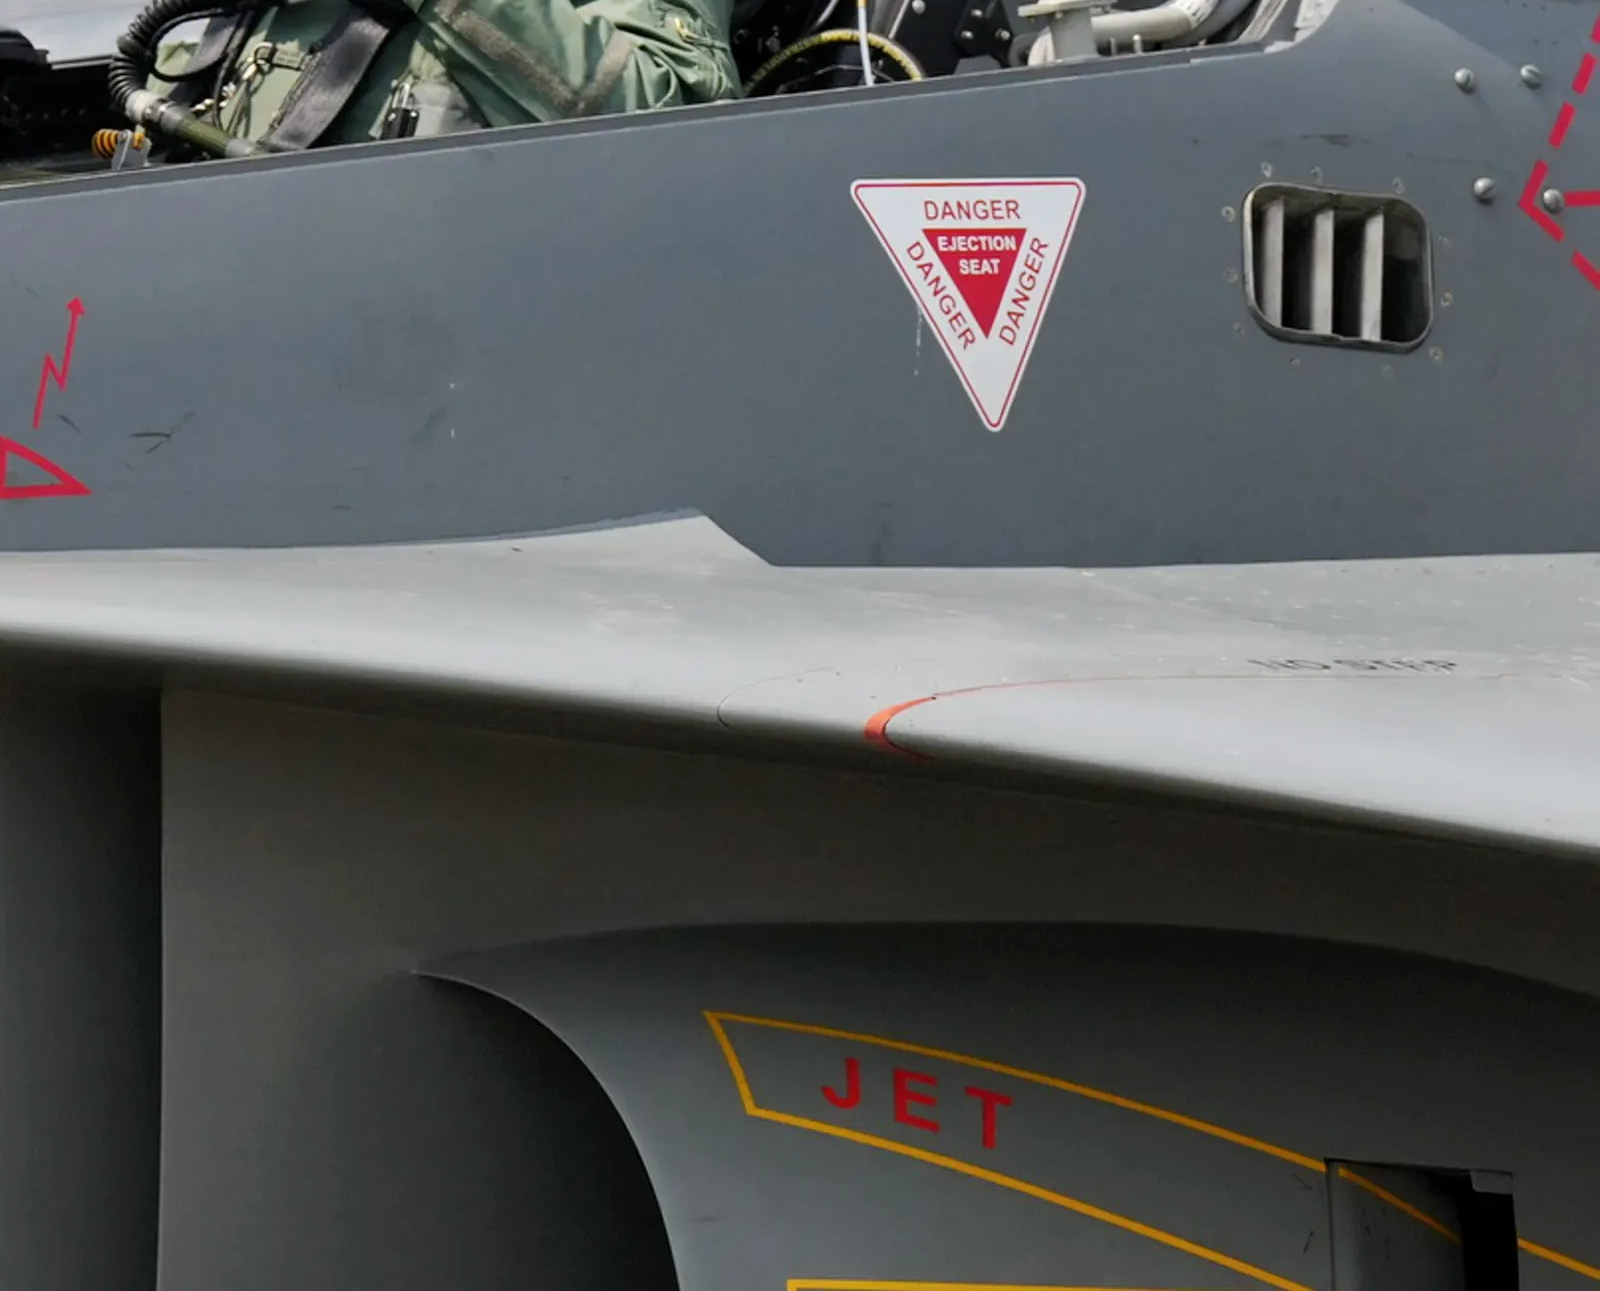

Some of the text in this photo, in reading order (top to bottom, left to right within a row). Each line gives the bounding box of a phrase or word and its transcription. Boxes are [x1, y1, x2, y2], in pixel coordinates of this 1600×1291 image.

[923, 199, 1021, 222] DANGER
[936, 235, 1017, 252] EJECTION
[959, 258, 1001, 275] SEAT
[906, 241, 976, 350] DANGER
[998, 237, 1050, 347] DANGER
[1333, 659, 1458, 672] STEP
[820, 1057, 1013, 1149] JET
